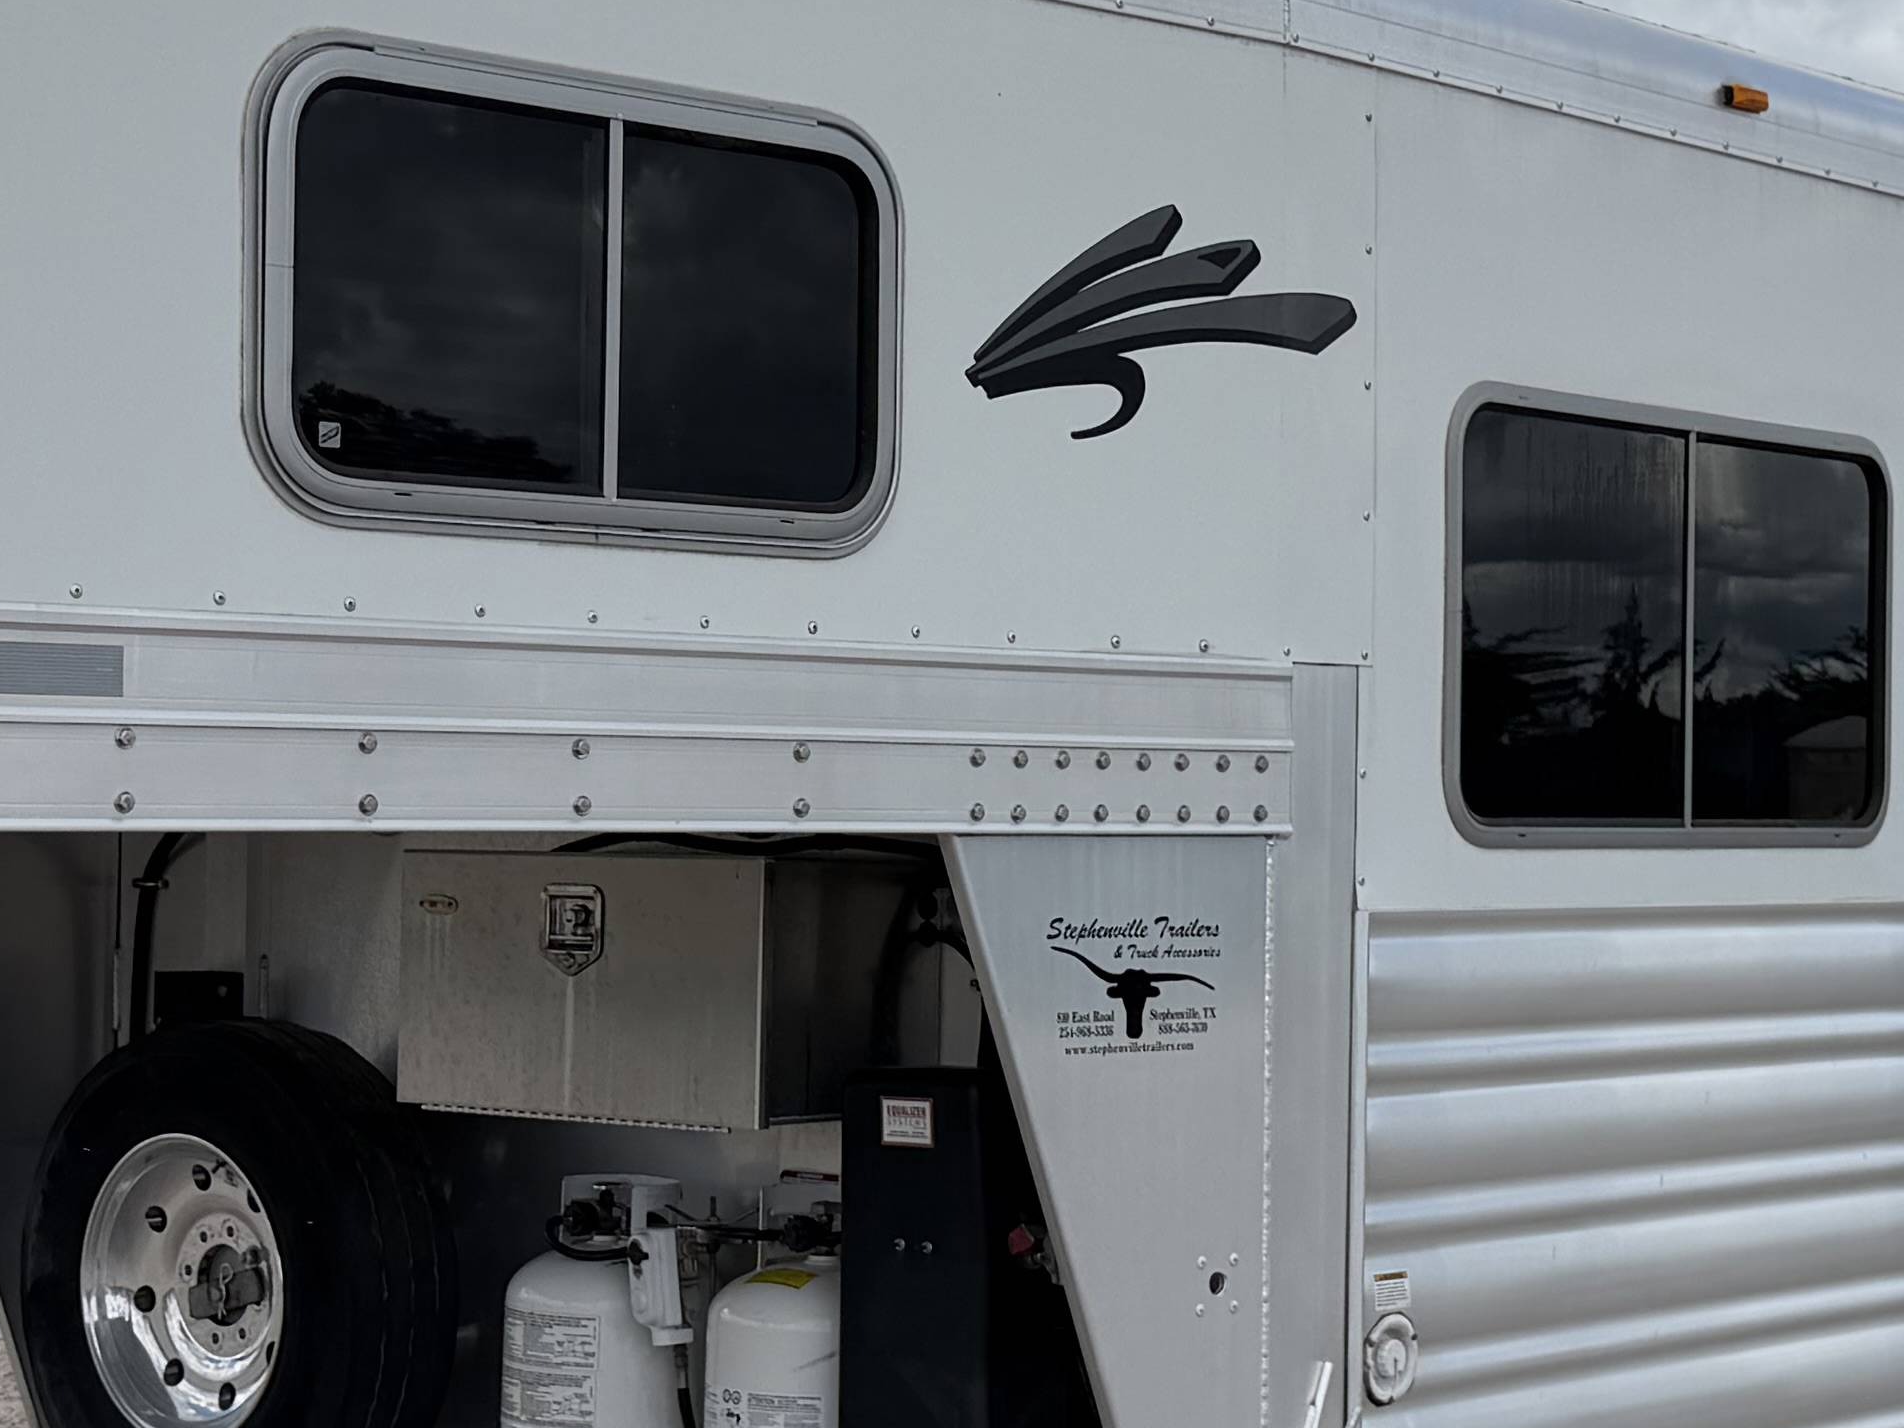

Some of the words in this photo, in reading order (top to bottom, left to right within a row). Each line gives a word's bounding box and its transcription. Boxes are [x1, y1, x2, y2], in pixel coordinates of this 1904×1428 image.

[1046, 917, 1149, 944] Stephenville
[1154, 916, 1220, 939] Trailers
[1113, 944, 1123, 959] &
[1127, 944, 1159, 959] Truck
[1161, 944, 1221, 959] Accessories
[1072, 1011, 1090, 1023] East
[1093, 1009, 1115, 1022] Road
[1202, 1007, 1217, 1019] TX
[1064, 1041, 1194, 1056] www.stephenvilletrailers.com
